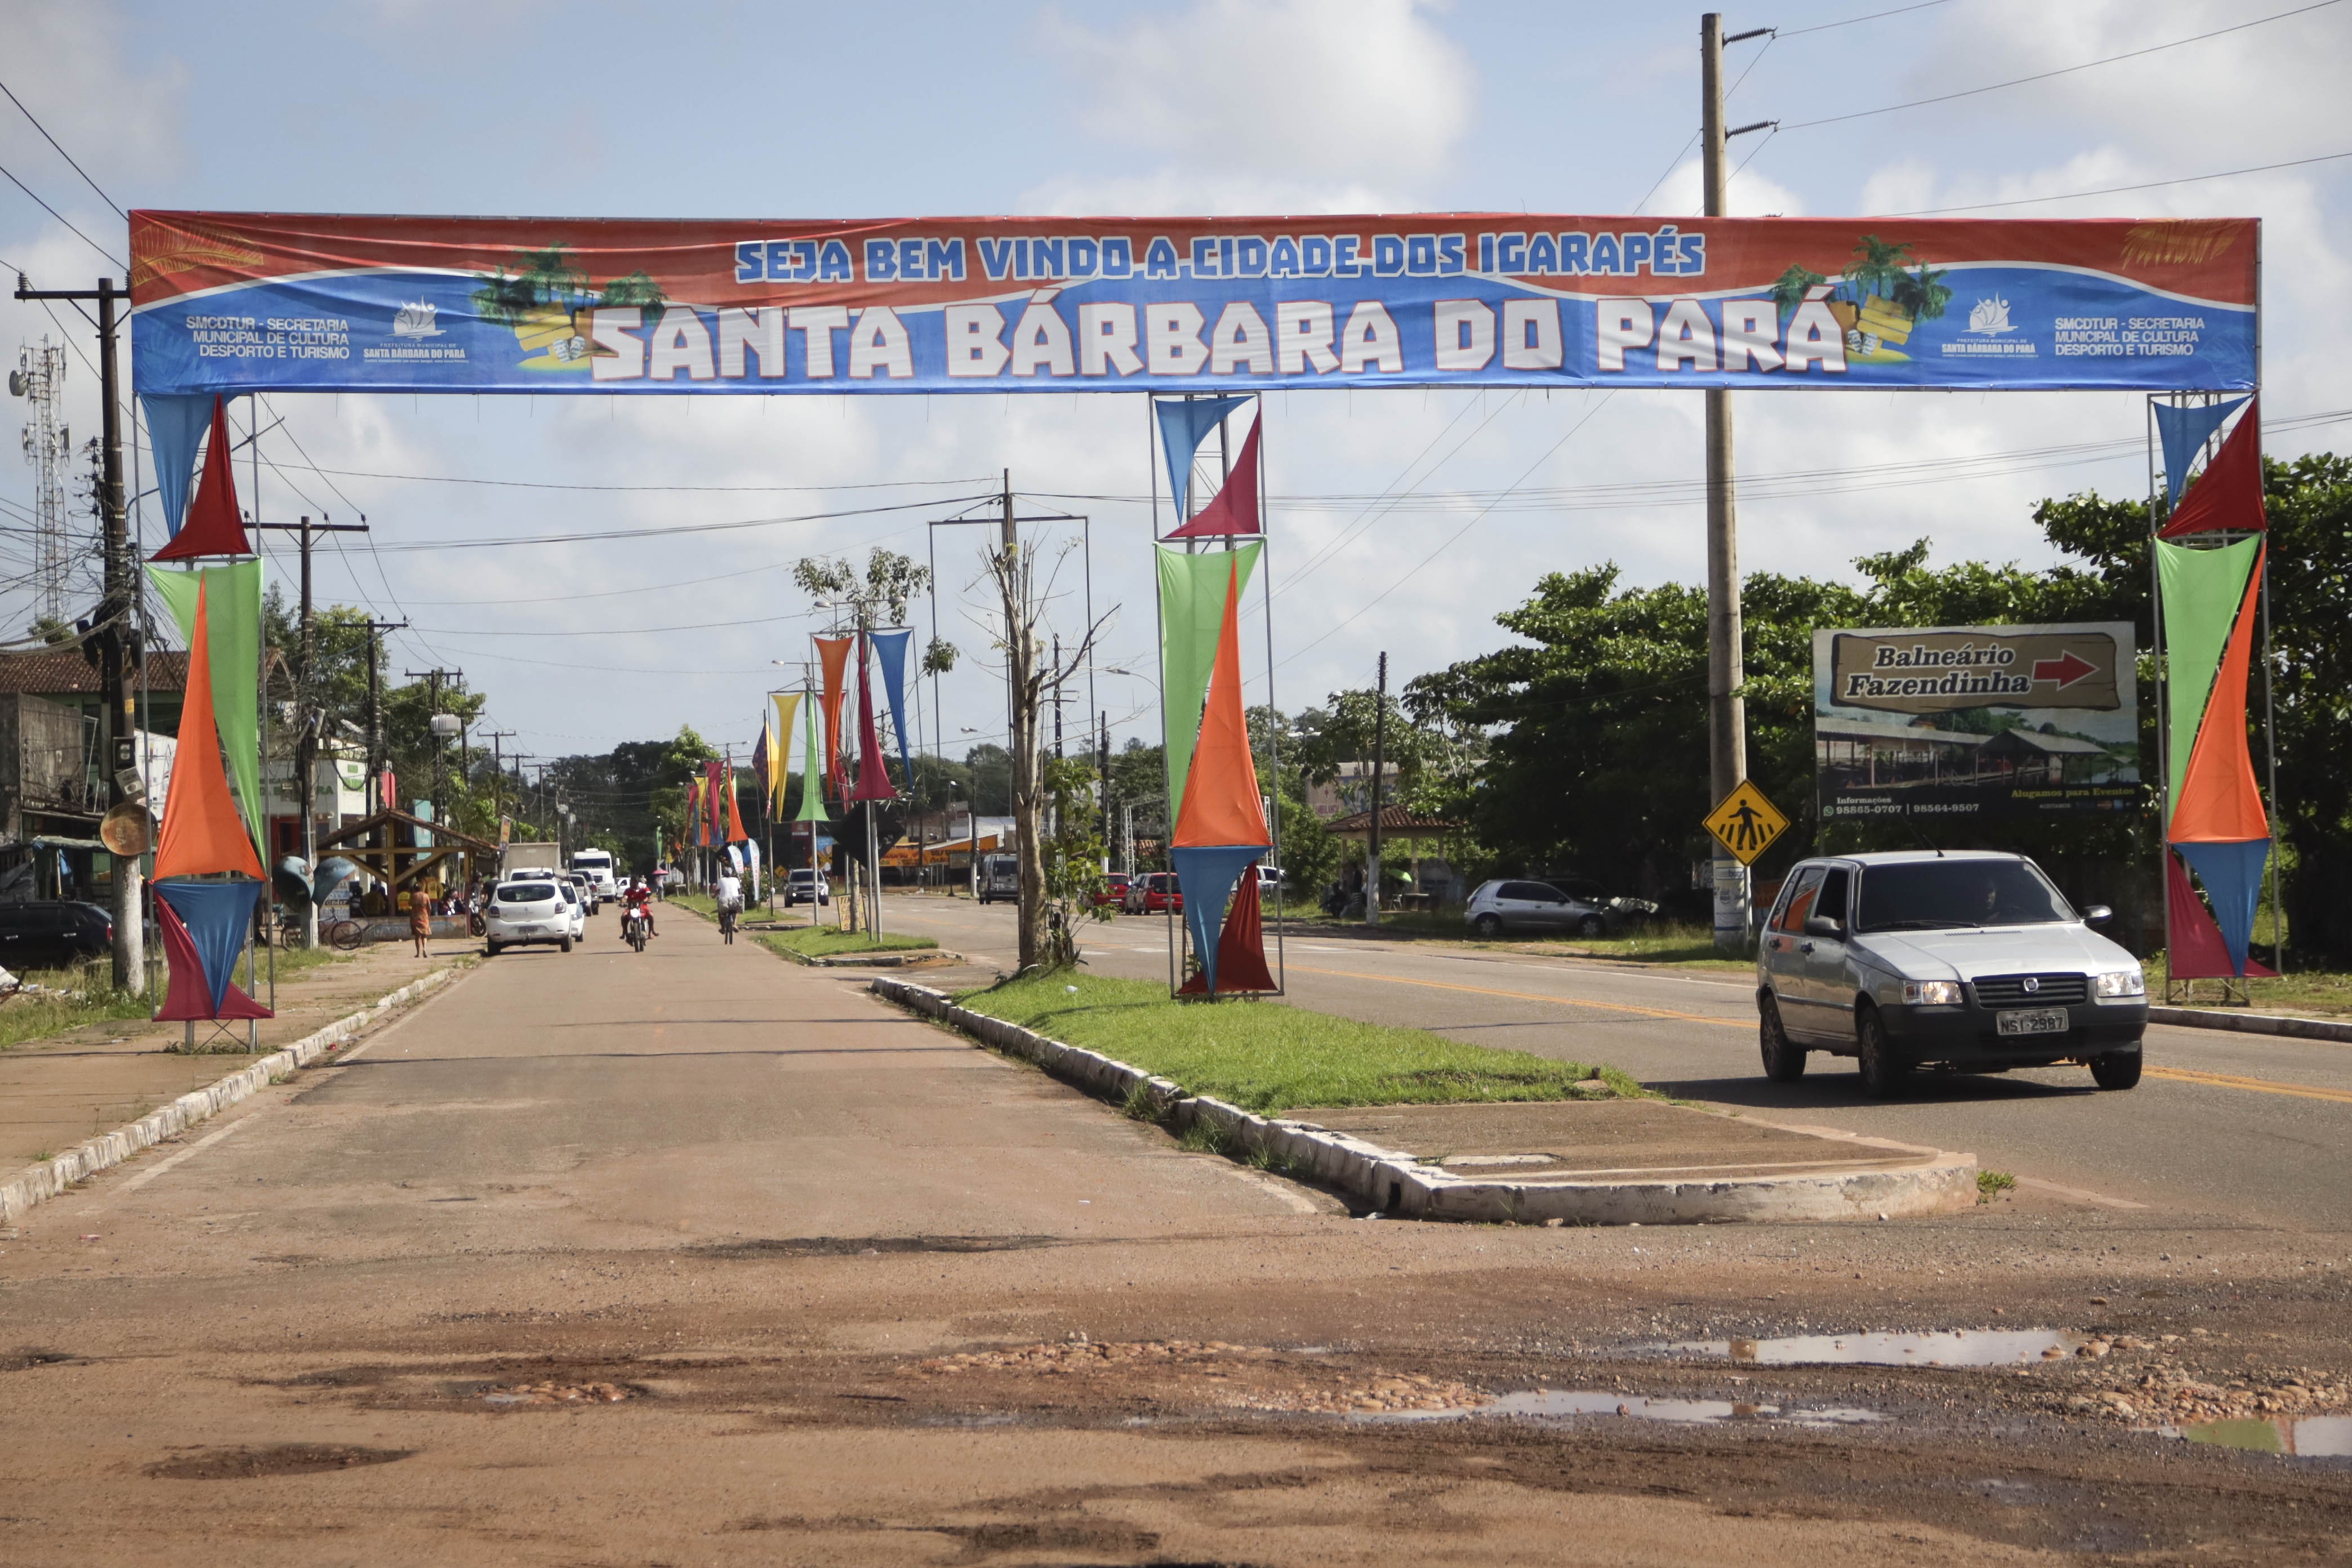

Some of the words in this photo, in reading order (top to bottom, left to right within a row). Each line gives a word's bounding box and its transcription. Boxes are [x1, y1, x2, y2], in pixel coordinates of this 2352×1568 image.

[735, 238, 854, 284] SEJA
[864, 237, 967, 283] BEM
[977, 235, 1133, 282] VINDO
[1144, 236, 1179, 280] A
[1191, 234, 1361, 279] CIDADE
[1372, 234, 1467, 278] DOS
[1478, 225, 1706, 278] IGARAPÉS
[186, 316, 255, 329] SMCDTUR
[267, 318, 349, 331] SECRETARIA
[2055, 317, 2118, 329] SMCDTUR
[2128, 317, 2205, 329] SECRETARIA
[193, 331, 264, 344] MUNICIPAL
[267, 332, 285, 344] DE
[289, 333, 349, 345] CULTURA
[591, 306, 915, 381] SANTA
[945, 287, 1404, 379] BÁRBARA
[1434, 298, 1563, 372] DO
[1597, 284, 1848, 373] PARÁ
[2055, 331, 2119, 343] MUNICIPAL
[2122, 331, 2139, 343] DE
[2142, 331, 2199, 343] CULTURA
[199, 345, 274, 358] DESPORTO
[277, 346, 286, 358] E
[290, 346, 349, 359] TURISMO
[363, 348, 390, 358] SANTA
[391, 347, 430, 358] BÁRBARA
[431, 349, 443, 358] DO
[444, 348, 465, 358] PARÁ
[1942, 344, 1966, 353] SANTA
[1967, 342, 2002, 353] BÁRBARA
[2003, 344, 2015, 353] DO
[2016, 342, 2036, 353] PARÁ
[2055, 344, 2123, 356] DESPORTO
[2126, 344, 2135, 356] E
[2137, 344, 2194, 356] TURISMO
[1874, 643, 2015, 669] Balneário
[1845, 671, 2031, 698] Fazendinha
[2011, 789, 2063, 799] Alugamos
[2065, 790, 2090, 798] para
[1837, 797, 1892, 805] Informações
